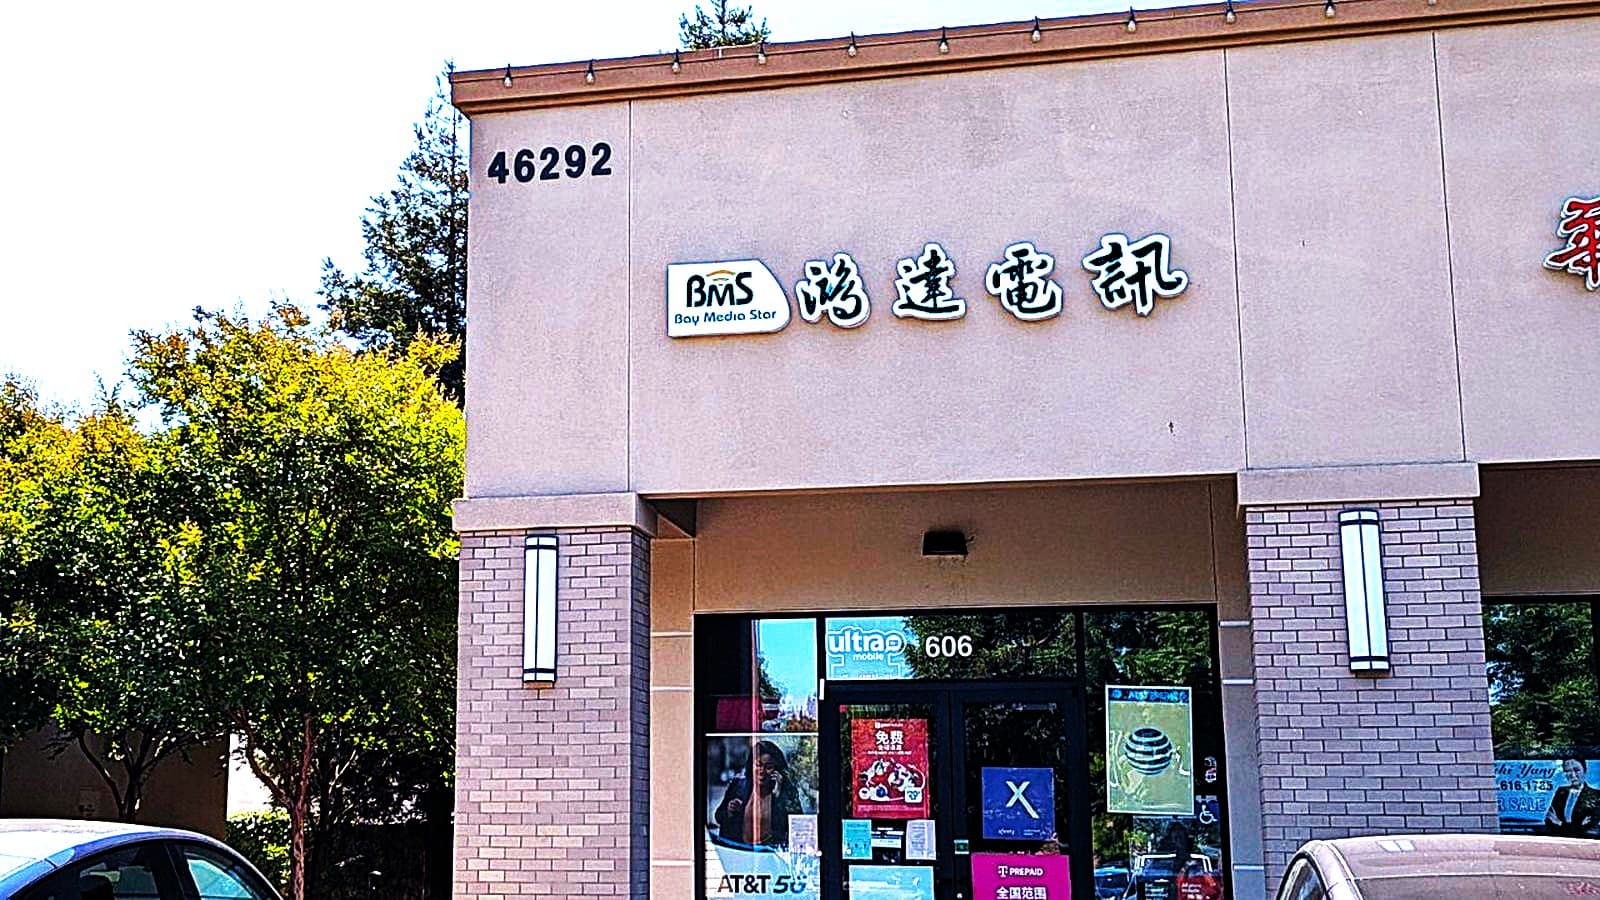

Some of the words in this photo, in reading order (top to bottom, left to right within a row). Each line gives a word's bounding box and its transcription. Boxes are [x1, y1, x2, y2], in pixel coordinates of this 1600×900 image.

[487, 142, 612, 184] 46292
[686, 271, 754, 308] BMS
[674, 313, 700, 327] Bay
[703, 310, 746, 323] Media
[749, 308, 777, 320] Star
[925, 634, 973, 658] 606
[852, 652, 885, 661] mobile
[875, 730, 904, 745] 免费
[1510, 796, 1546, 811] SALE
[1009, 867, 1044, 876] PREPAID
[717, 874, 771, 894] AT&T
[996, 886, 1047, 900] 全国范围
